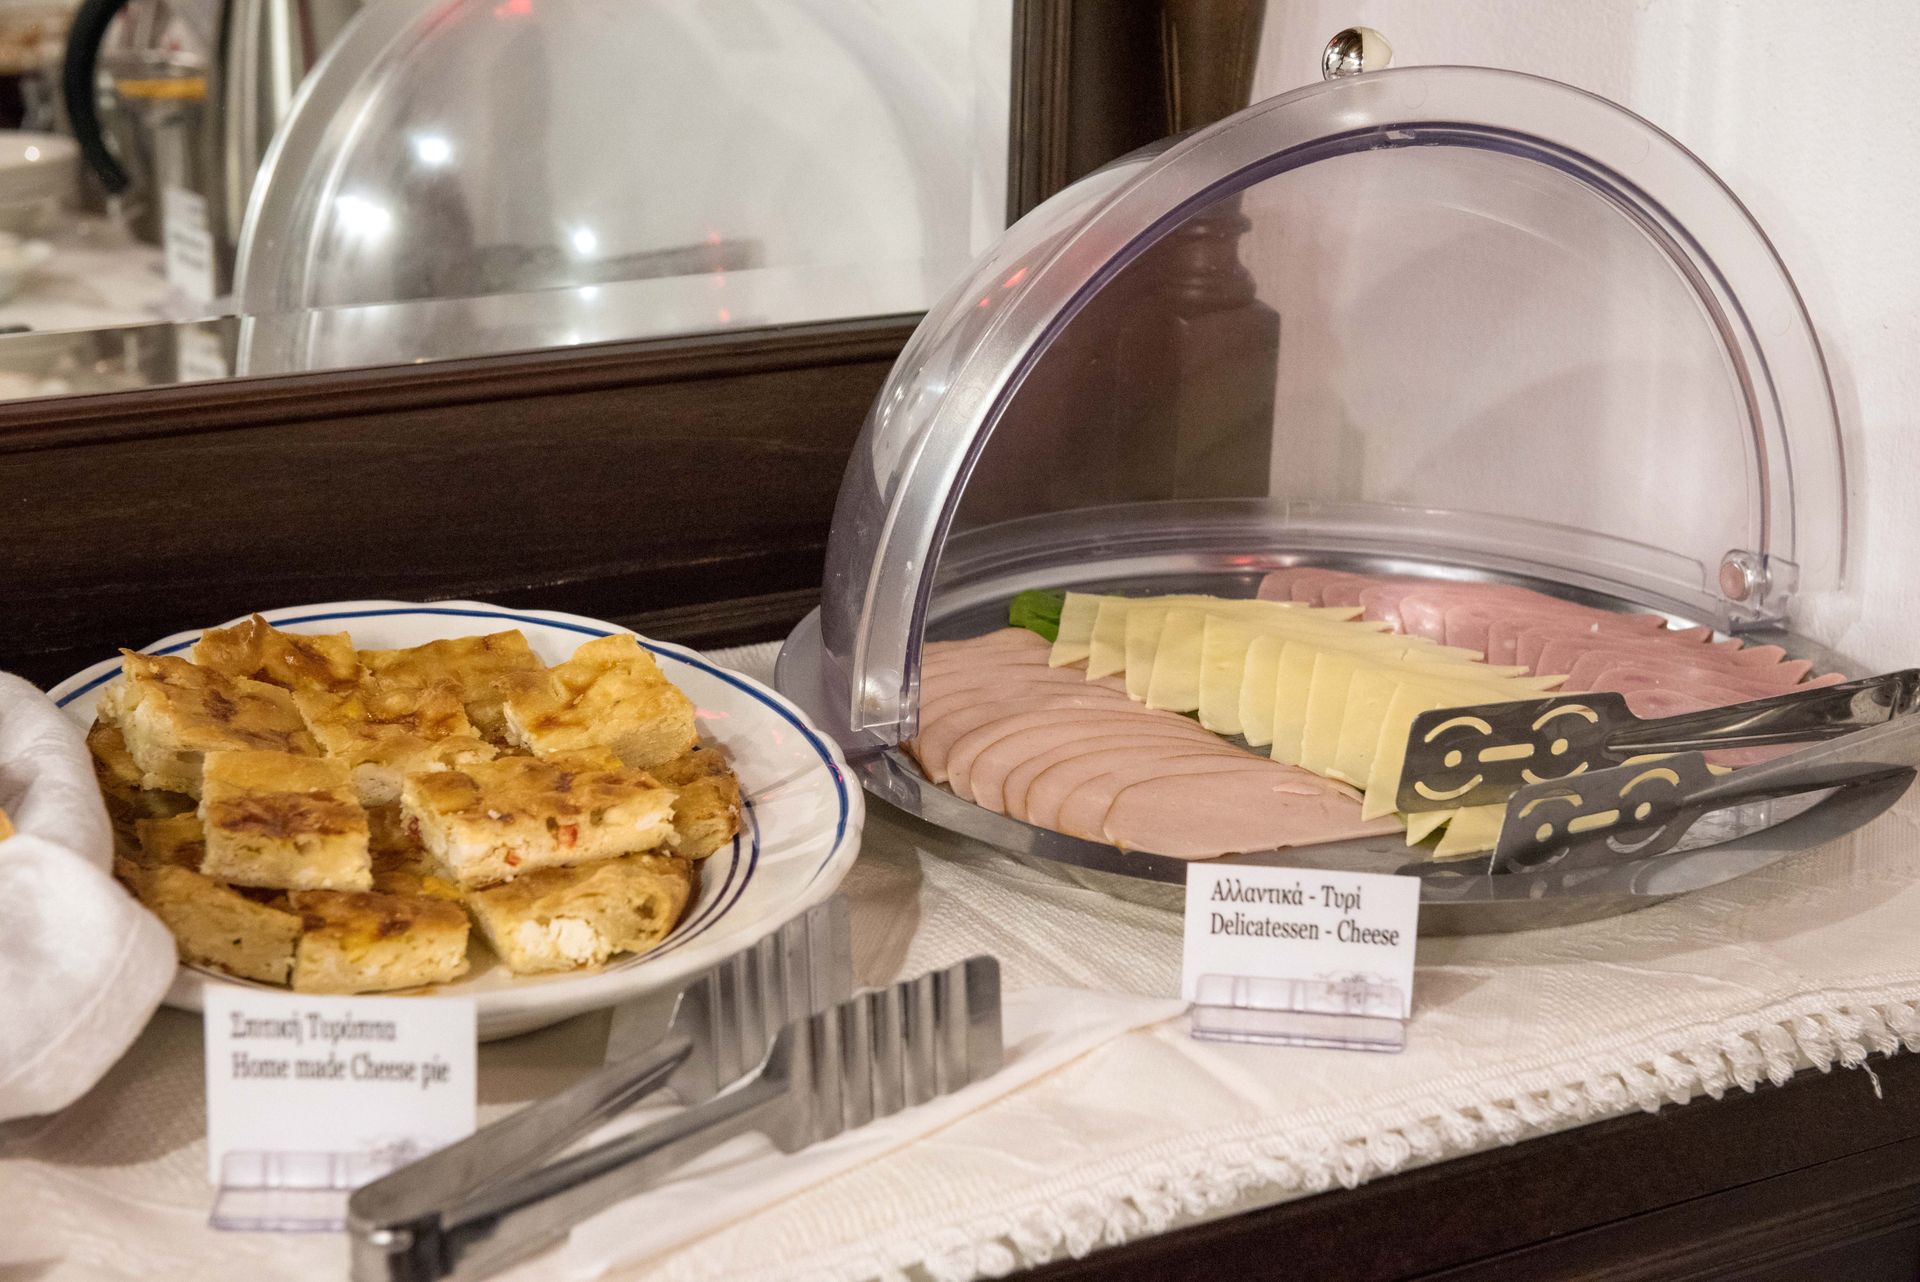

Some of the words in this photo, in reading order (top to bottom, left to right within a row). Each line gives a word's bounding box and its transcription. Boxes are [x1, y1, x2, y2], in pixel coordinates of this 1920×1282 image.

[1210, 877, 1304, 906] Αλλαντικά
[1321, 885, 1362, 914] Τυρί
[1210, 912, 1320, 941] Delicatessen
[1337, 919, 1400, 946] Cheese
[231, 1052, 290, 1080] Home
[294, 1052, 346, 1081] made
[351, 1053, 416, 1082] Cheese
[421, 1054, 451, 1090] pie
